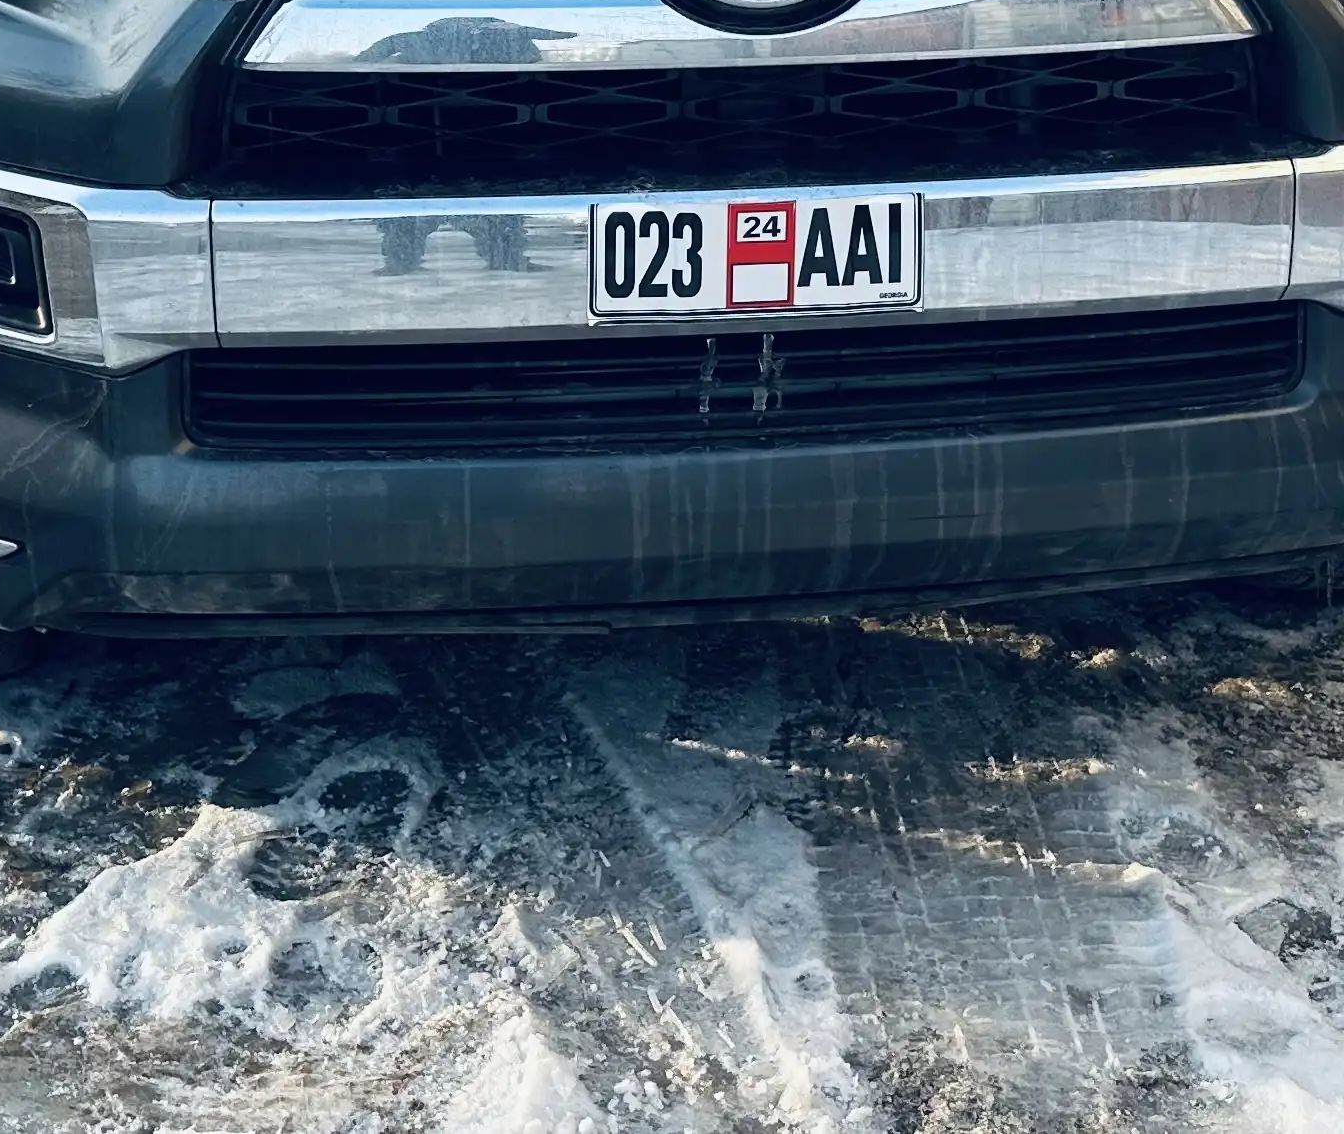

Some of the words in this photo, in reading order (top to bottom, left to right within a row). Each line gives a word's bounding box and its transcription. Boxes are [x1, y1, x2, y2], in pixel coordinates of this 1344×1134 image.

[605, 211, 703, 299] 023
[797, 202, 902, 288] AAI
[742, 216, 782, 240] 24
